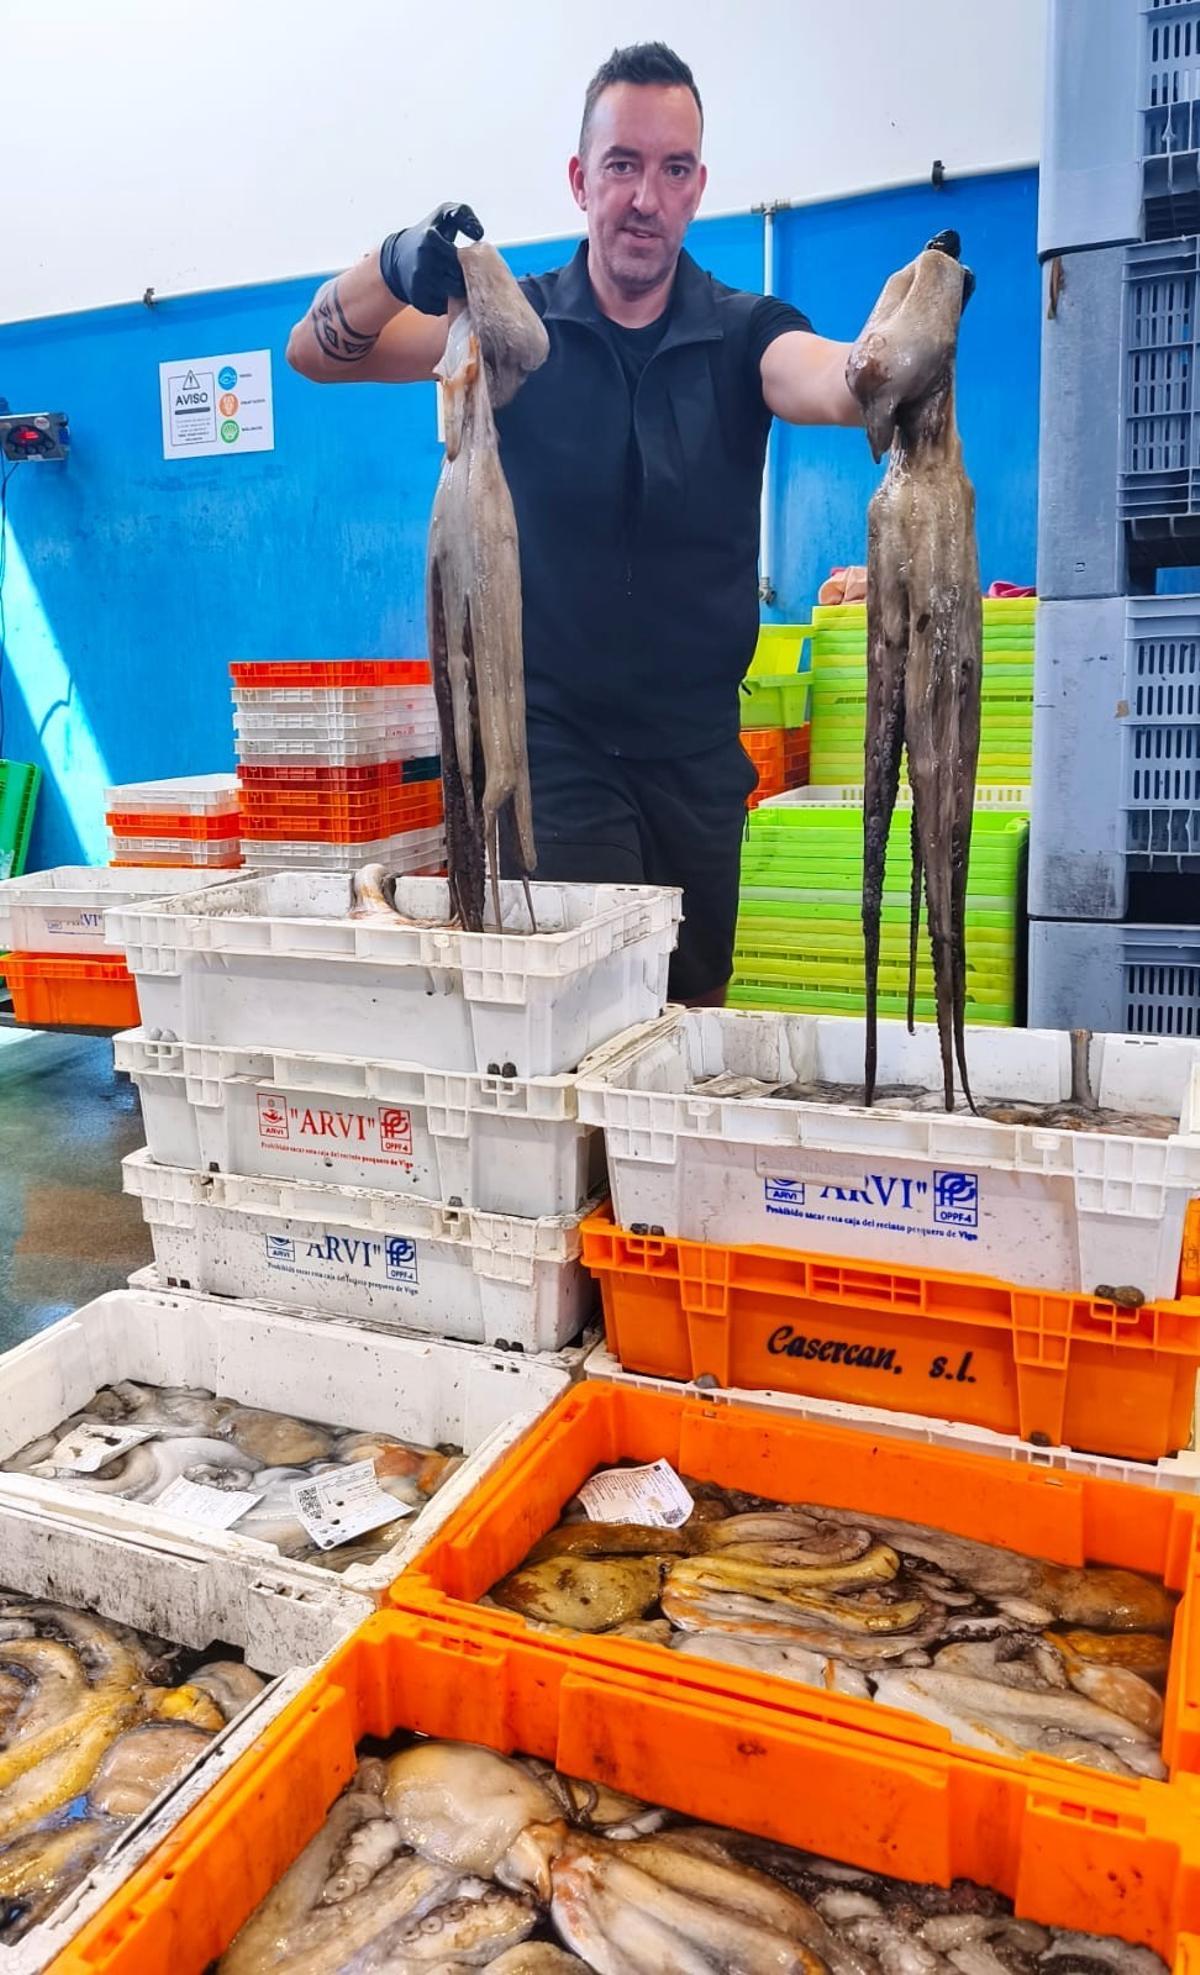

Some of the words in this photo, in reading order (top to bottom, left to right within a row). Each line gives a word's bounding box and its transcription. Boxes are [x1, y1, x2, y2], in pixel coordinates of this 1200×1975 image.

[175, 392, 209, 406] AVISO
[290, 1107, 375, 1140] "ARVI"
[773, 1190, 797, 1201] ARVI
[766, 1204, 803, 1218] Prohibido
[805, 1212, 825, 1220] sacar
[844, 1216, 860, 1226] caja
[862, 1218, 875, 1227] del
[876, 1222, 905, 1231] recinto
[906, 1226, 944, 1237] pesquero
[946, 1229, 956, 1238] de
[958, 1230, 978, 1241] Vigo
[940, 1211, 973, 1224] OPPF-4
[928, 1350, 977, 1383] s.l.
